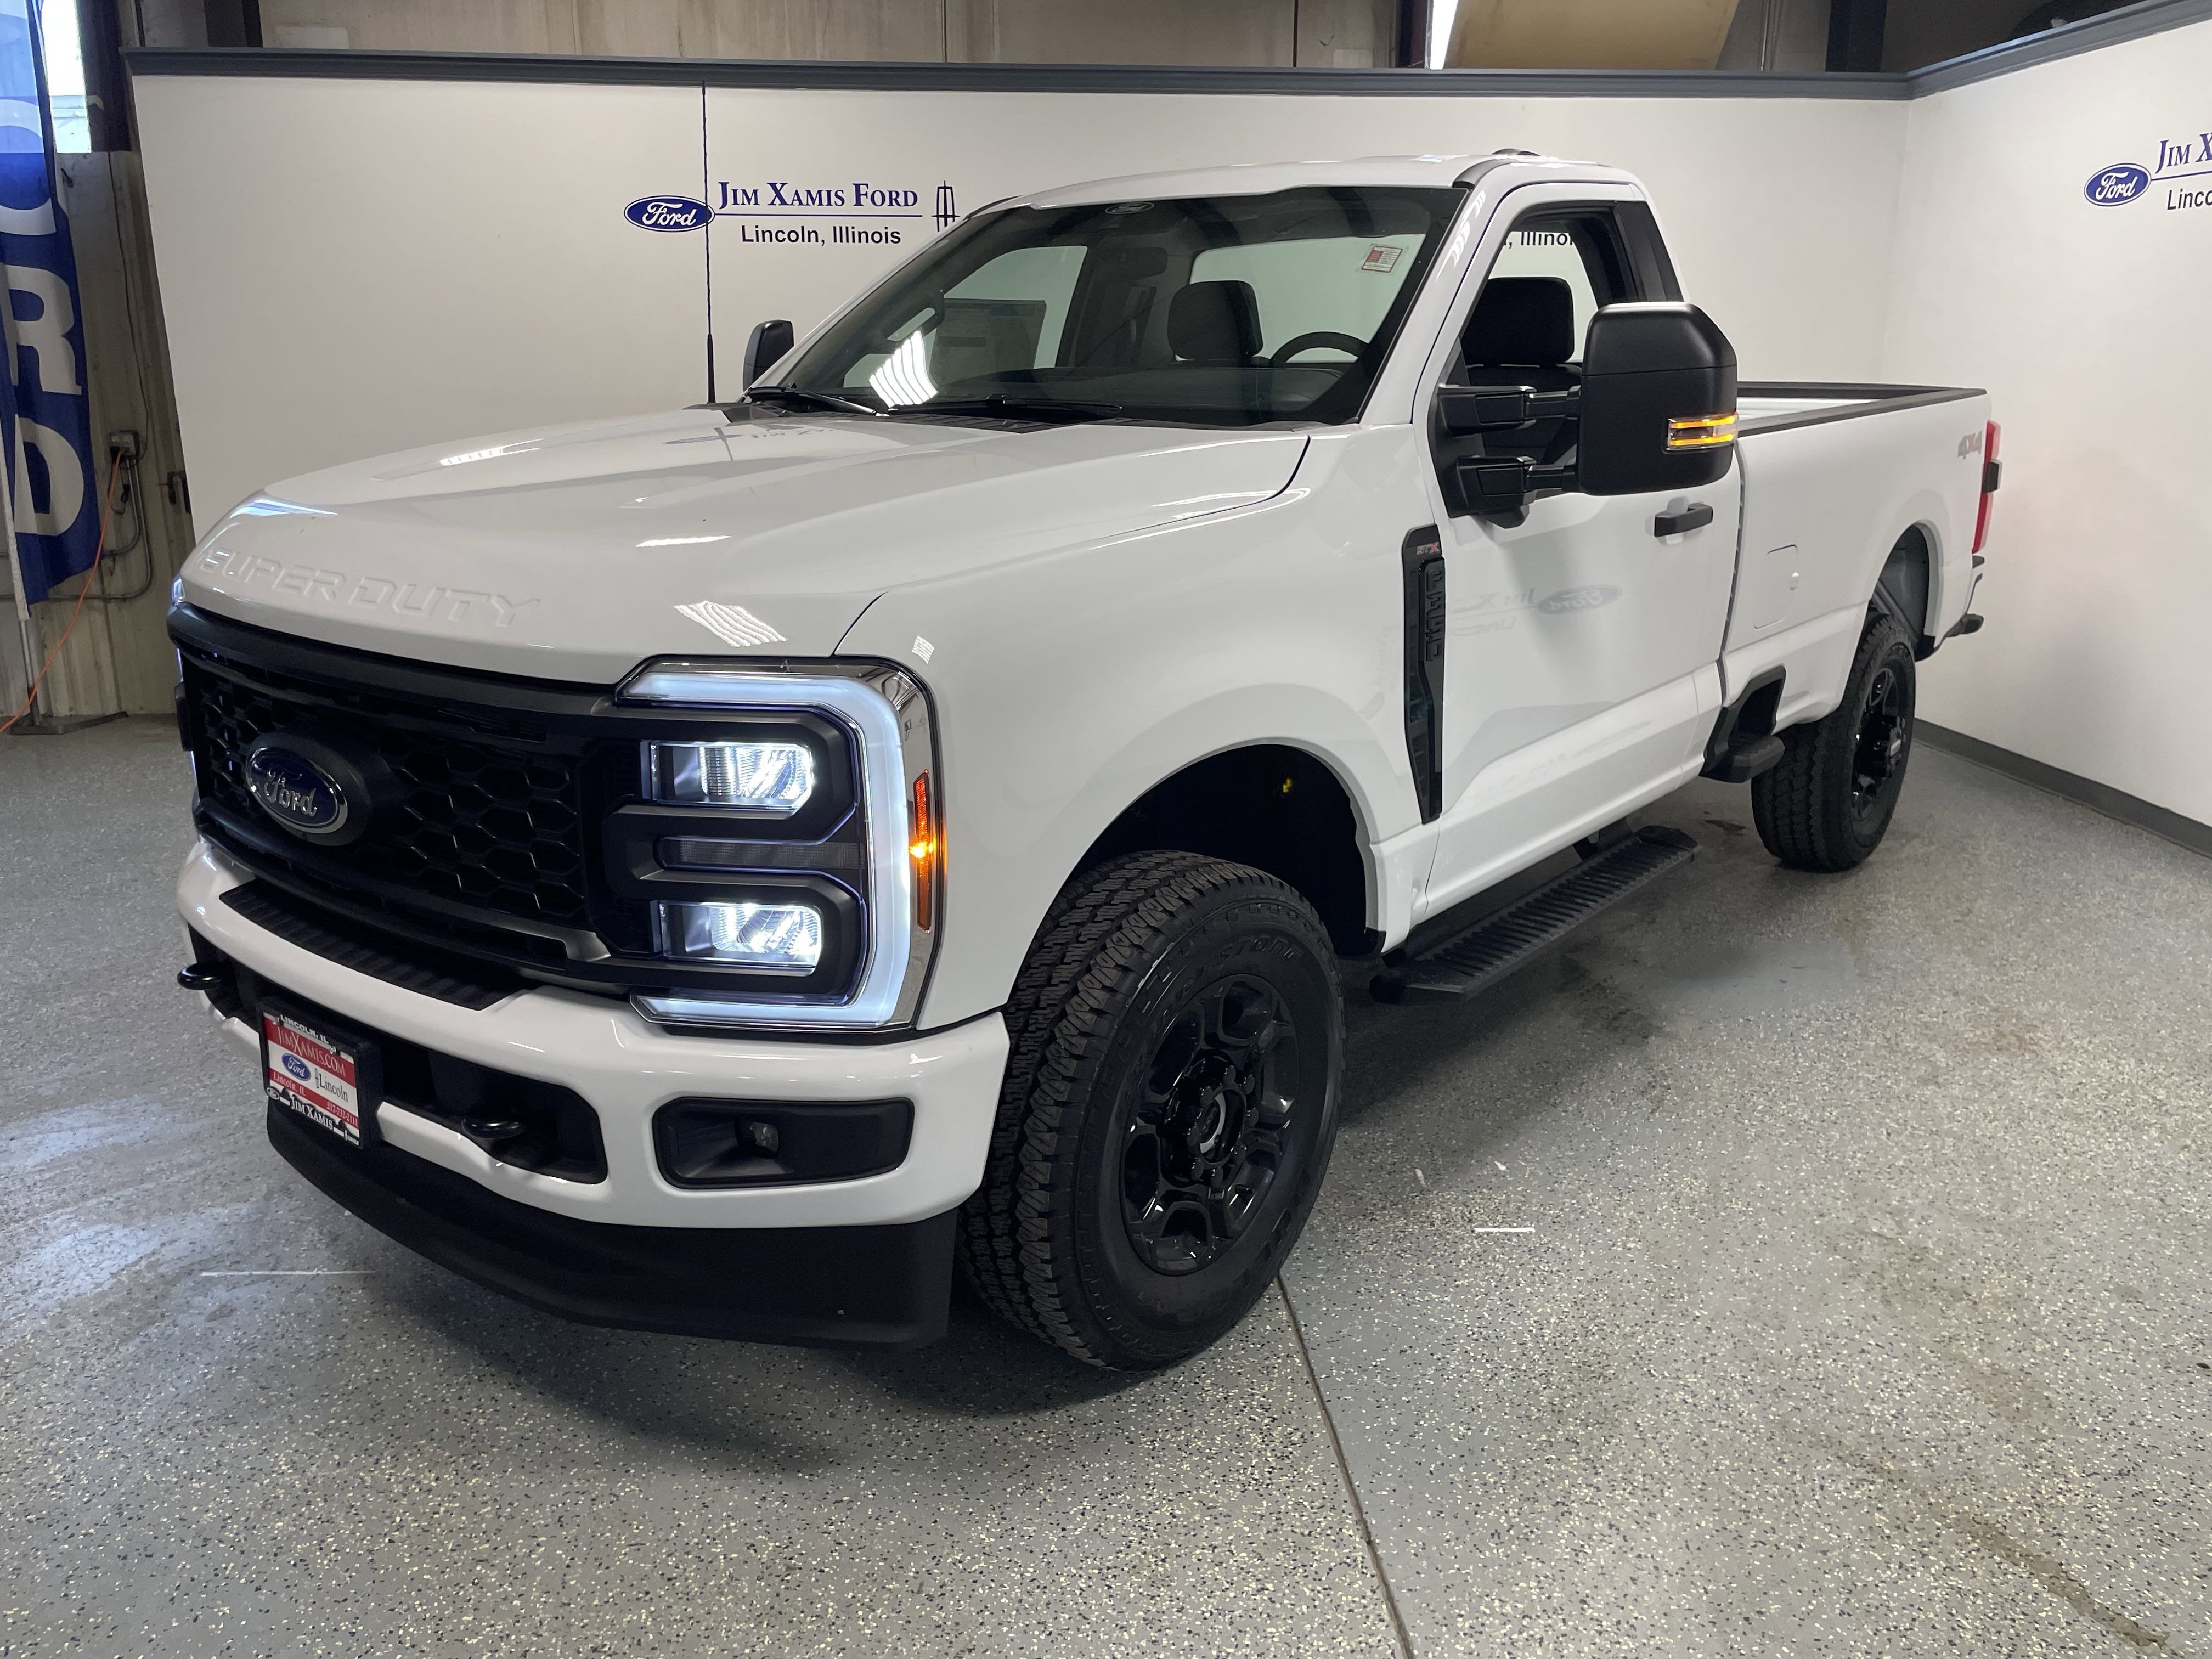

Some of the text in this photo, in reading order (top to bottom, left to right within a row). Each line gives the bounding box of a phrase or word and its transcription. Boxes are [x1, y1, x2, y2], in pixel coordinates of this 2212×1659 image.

[2155, 139, 2191, 174] JIM
[718, 182, 918, 210] JIM XAMIS FORD
[2096, 172, 2138, 200] Ford
[642, 202, 696, 227] Ford
[741, 225, 901, 246] Lincoln, Illinois
[200, 548, 541, 628] SUPER DUTY
[263, 763, 317, 817] Ford
[287, 1057, 305, 1077] Ford
[319, 1073, 349, 1102] Lincoln
[291, 1096, 333, 1130] JIM XAMIS
